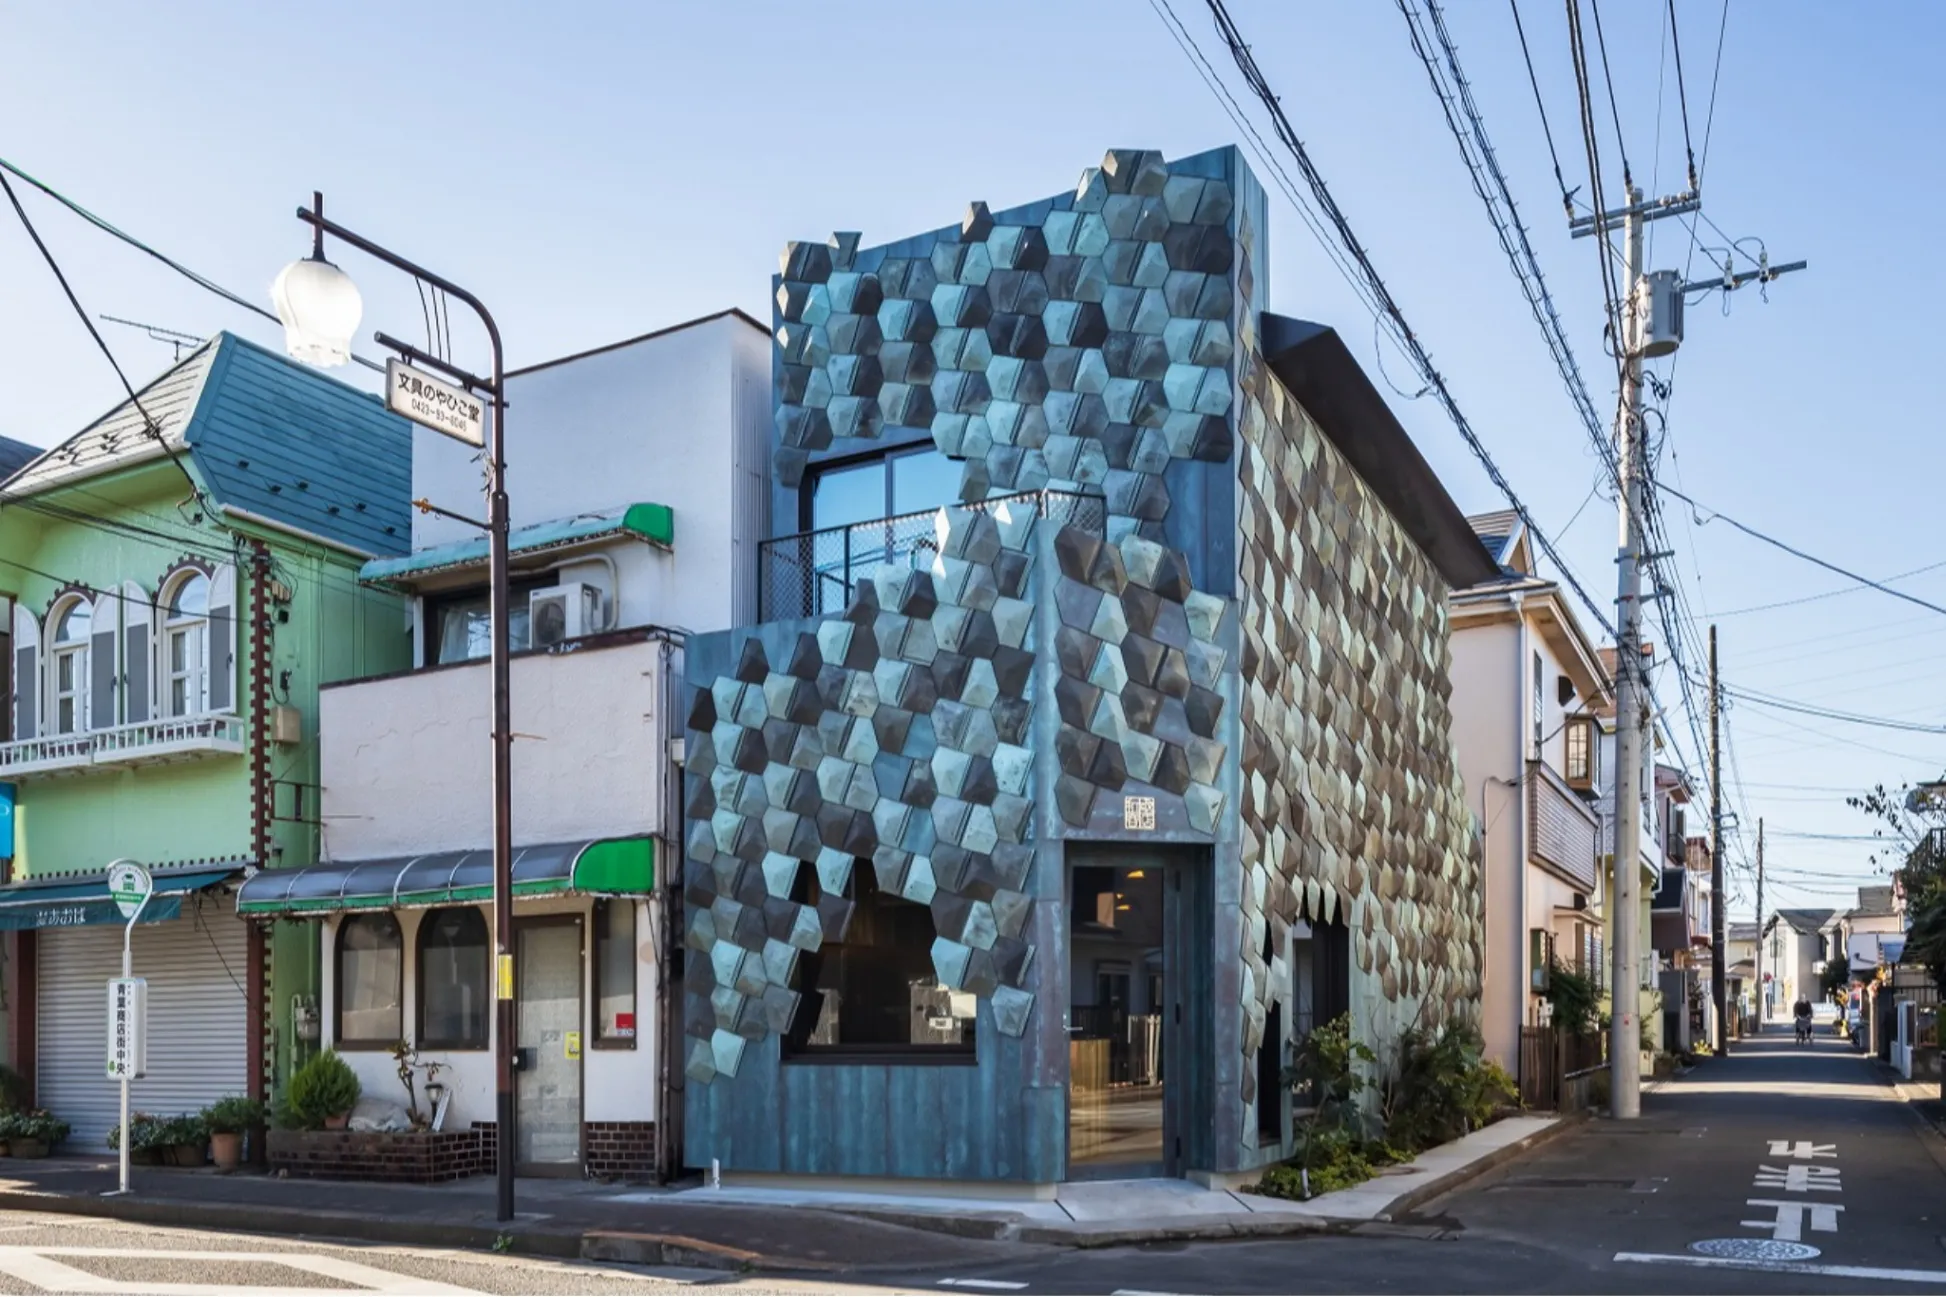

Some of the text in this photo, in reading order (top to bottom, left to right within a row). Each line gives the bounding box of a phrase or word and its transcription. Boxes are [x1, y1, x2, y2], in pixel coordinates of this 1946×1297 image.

[398, 372, 480, 423] 文具のやひこ堂
[116, 983, 126, 1075] 青葉商店街中央
[1740, 1140, 1846, 1241] 止まれ
